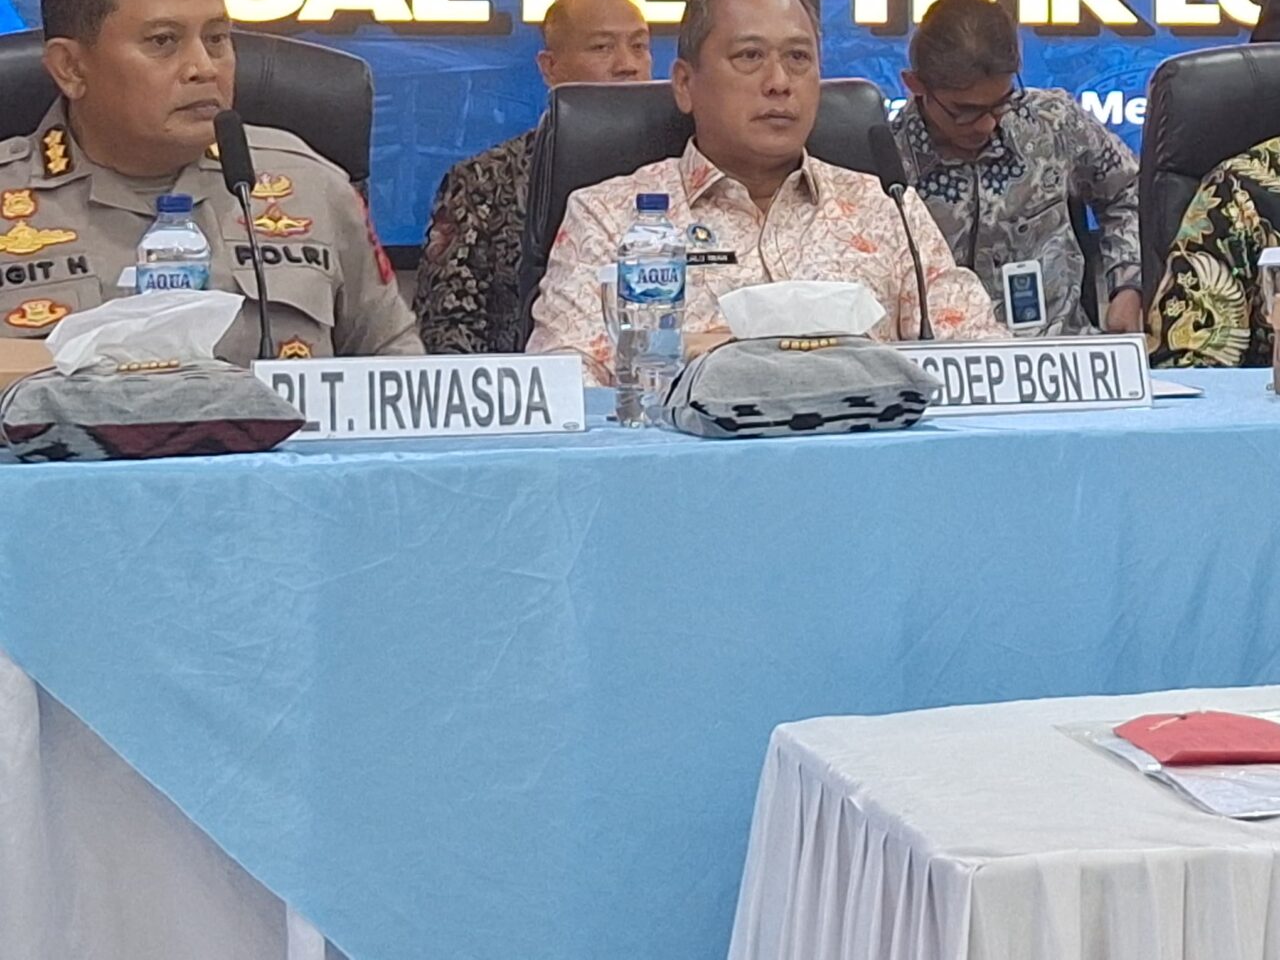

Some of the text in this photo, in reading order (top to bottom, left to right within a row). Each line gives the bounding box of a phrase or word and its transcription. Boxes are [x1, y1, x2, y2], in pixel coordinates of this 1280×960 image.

[67, 255, 88, 275] H
[636, 267, 679, 287] AQUA
[1014, 351, 1083, 403] BGN
[1089, 350, 1122, 400] RI
[367, 366, 552, 431] IRWASDA
